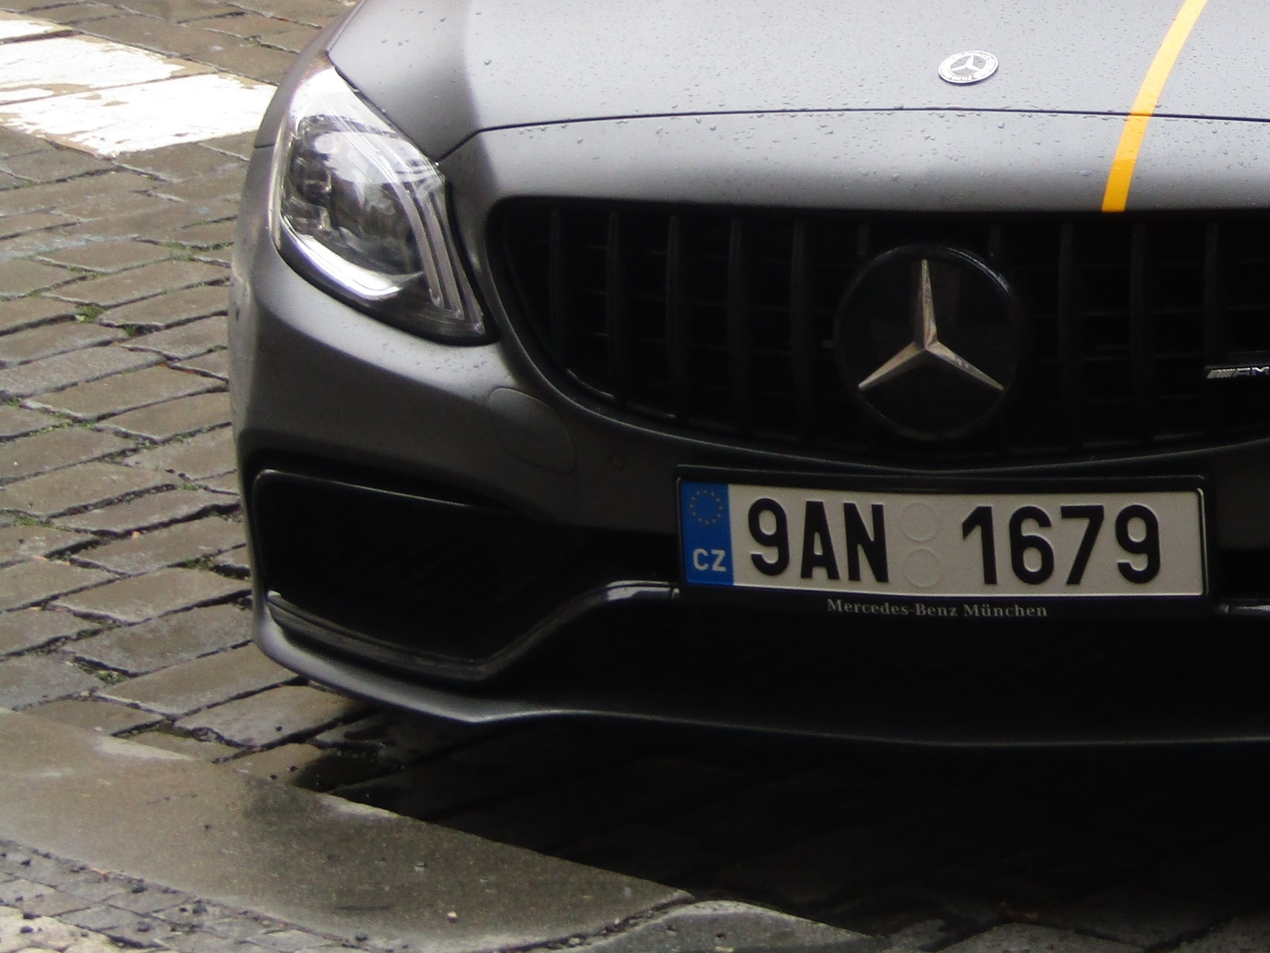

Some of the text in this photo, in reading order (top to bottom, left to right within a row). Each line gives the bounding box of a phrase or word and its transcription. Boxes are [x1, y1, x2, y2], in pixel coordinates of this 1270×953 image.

[747, 497, 1162, 585] 9AN 1679
[693, 548, 726, 572] CZ
[827, 598, 1048, 617] Mercedes-Benz München
